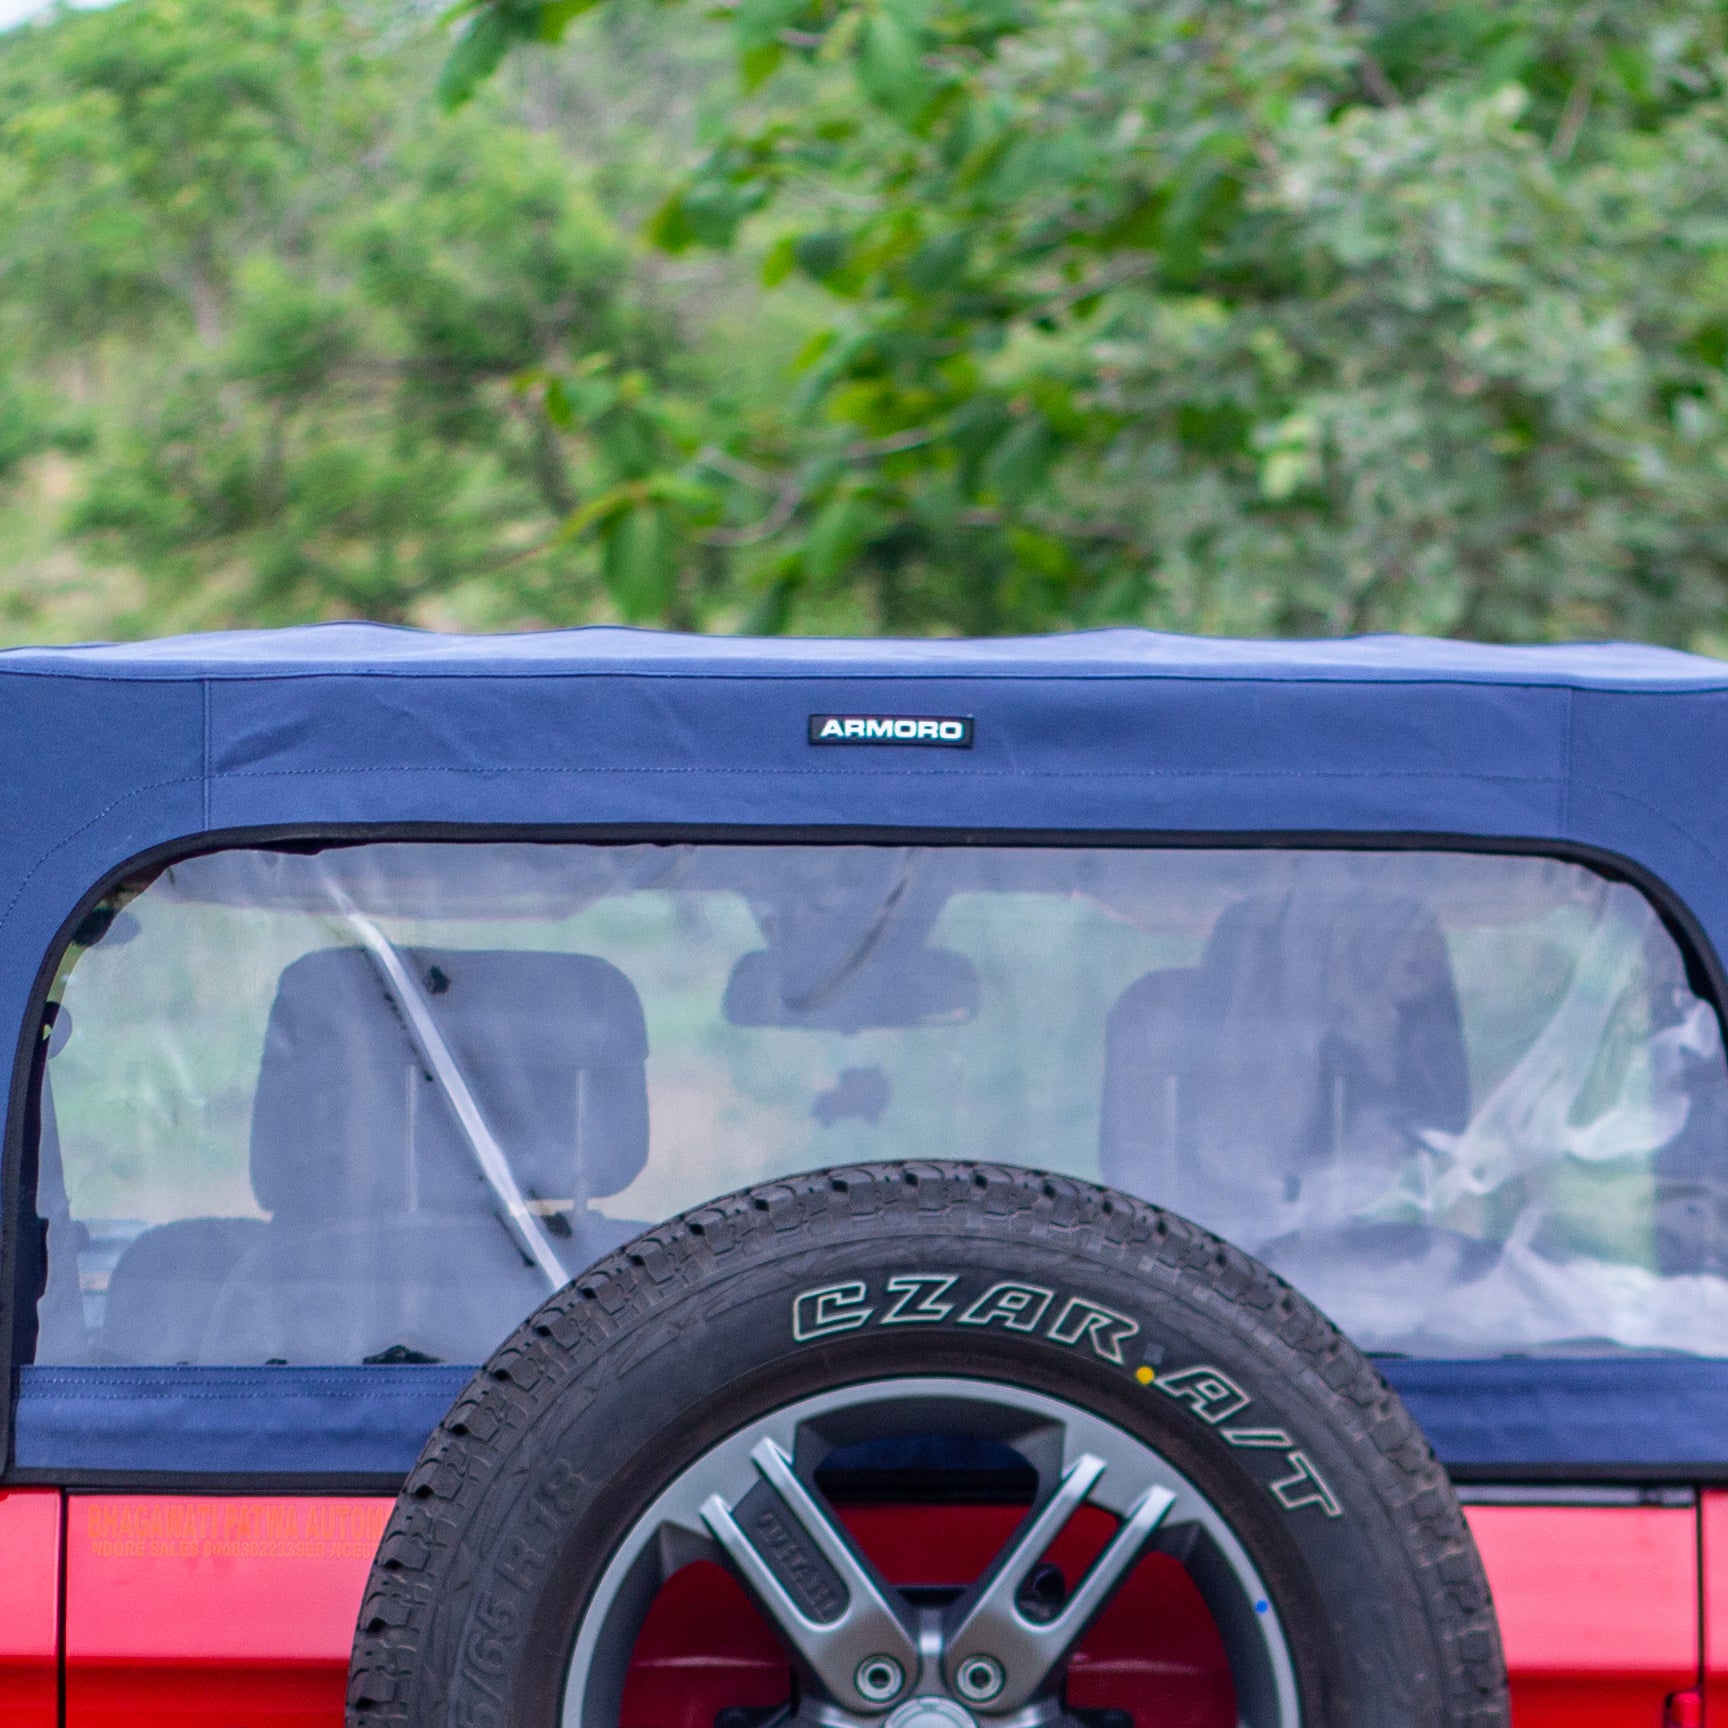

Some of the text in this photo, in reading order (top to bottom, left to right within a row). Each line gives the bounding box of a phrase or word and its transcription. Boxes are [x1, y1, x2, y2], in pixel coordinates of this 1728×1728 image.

[819, 718, 964, 740] ARMORO
[792, 1273, 1343, 1518] CZAR A/T
[87, 1503, 217, 1539] BHAGAWATI
[224, 1503, 299, 1539] PATWA
[151, 1541, 198, 1557] SALES
